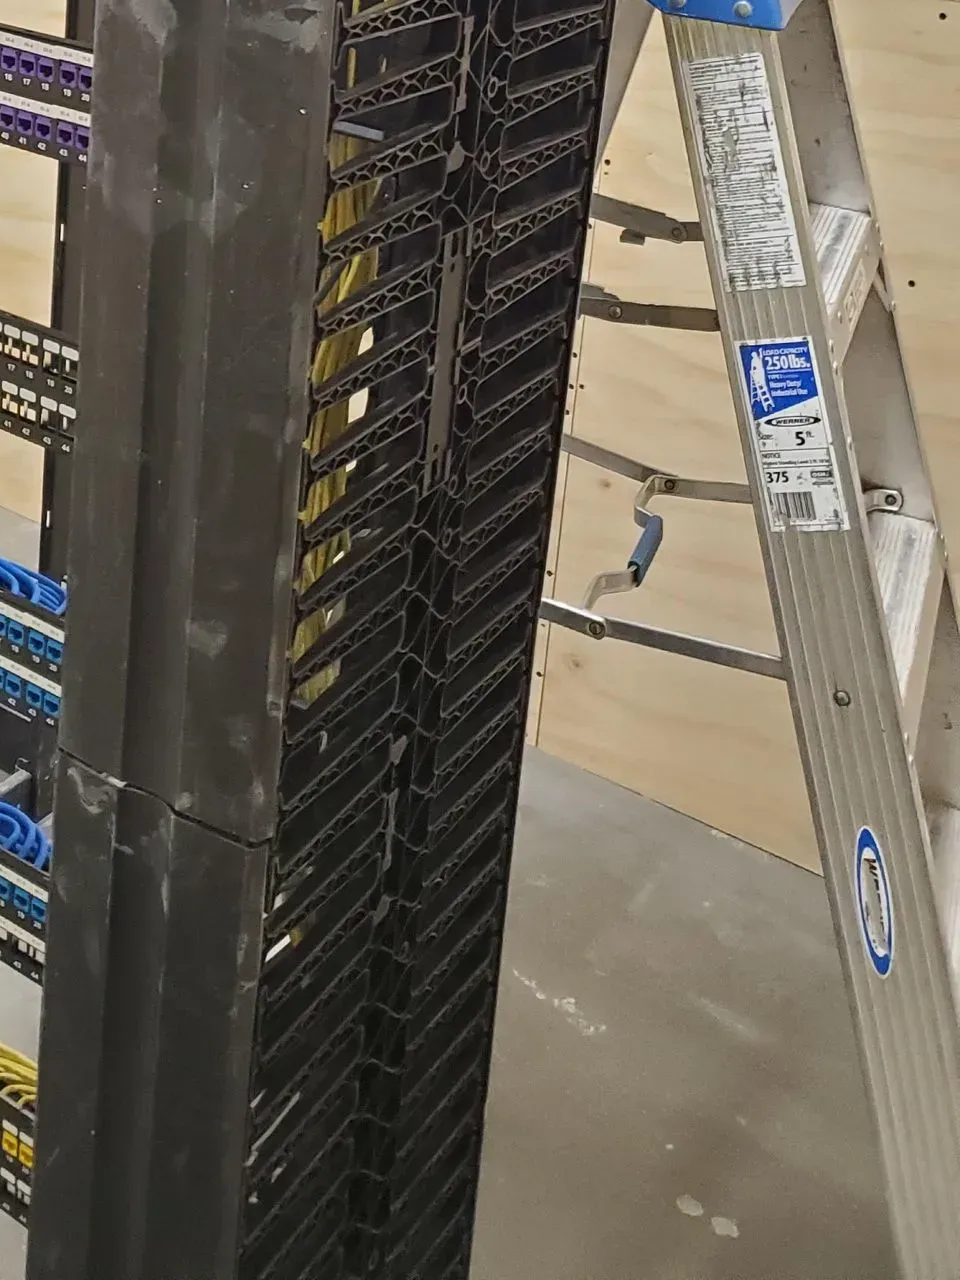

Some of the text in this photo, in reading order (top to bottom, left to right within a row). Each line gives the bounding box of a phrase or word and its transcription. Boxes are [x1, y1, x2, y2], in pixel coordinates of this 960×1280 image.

[762, 346, 808, 356] LOAD CAPACITY
[795, 431, 805, 446] 5
[765, 470, 789, 483] 375
